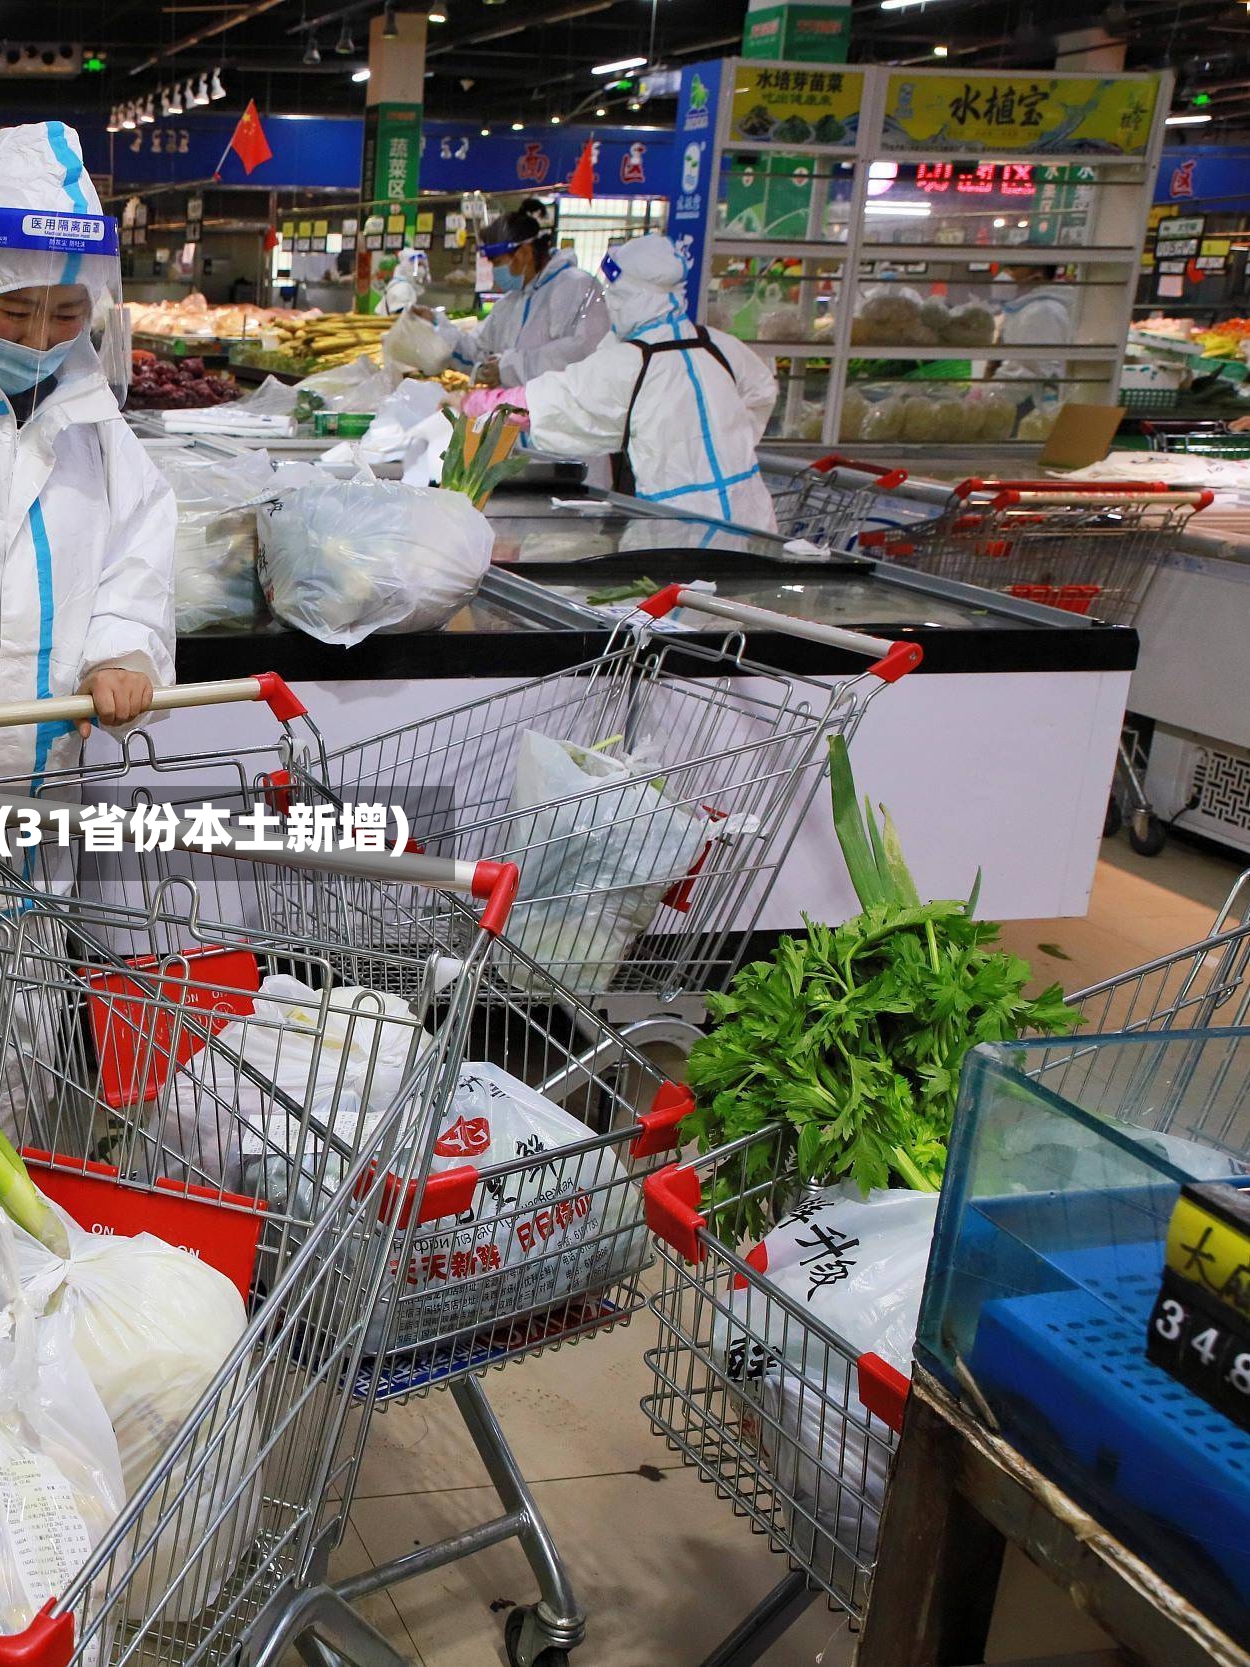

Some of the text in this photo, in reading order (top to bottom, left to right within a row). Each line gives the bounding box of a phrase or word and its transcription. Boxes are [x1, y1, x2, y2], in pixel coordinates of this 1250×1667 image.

[949, 84, 1049, 127] 水植宝
[388, 138, 409, 199] 蔬菜区
[31, 217, 100, 234] 医用隔离面罩
